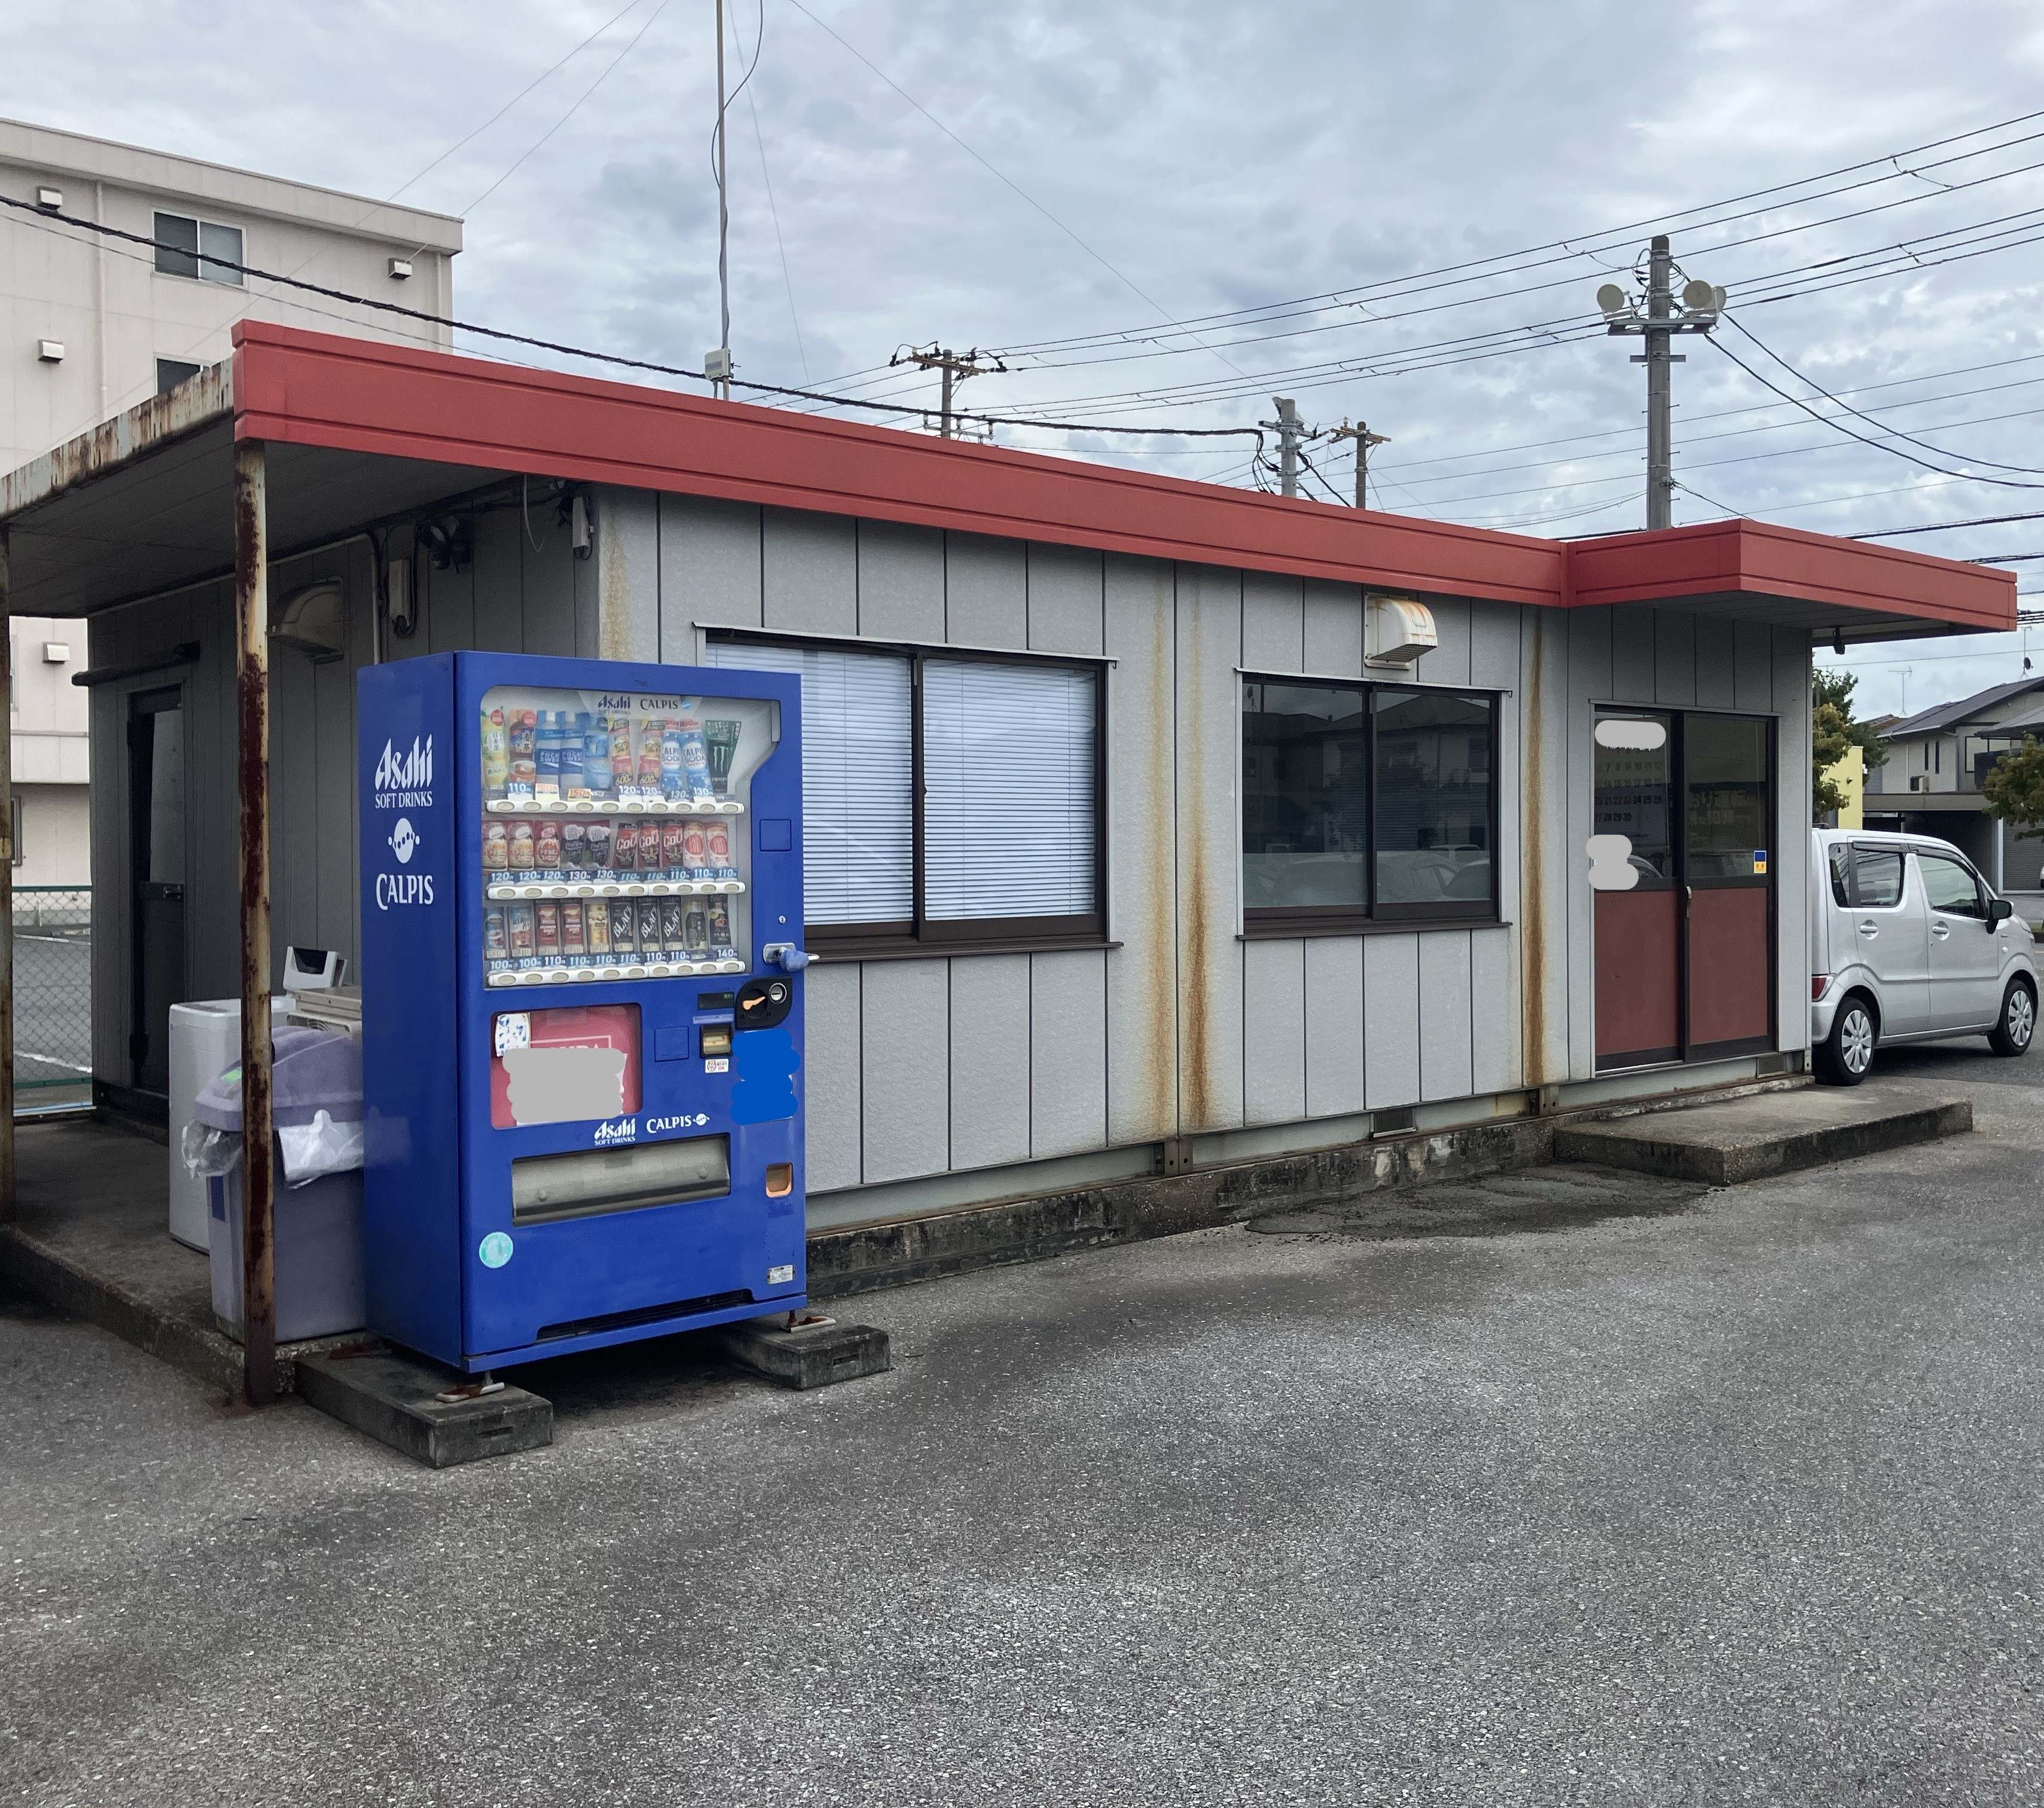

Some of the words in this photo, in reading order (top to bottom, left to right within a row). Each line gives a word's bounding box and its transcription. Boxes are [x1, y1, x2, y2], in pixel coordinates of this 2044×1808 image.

[598, 694, 631, 709] Asahi
[640, 698, 678, 711] CALPIS
[375, 734, 432, 790] Asahi
[375, 792, 396, 809] SOFT
[398, 790, 432, 808] DRINKS
[376, 873, 434, 911] CALPIS
[613, 905, 633, 939] BLAC
[640, 906, 657, 939] BLAC
[663, 905, 681, 937] BLAC
[594, 1117, 636, 1140] Asahi
[646, 1114, 692, 1134] CALPIS
